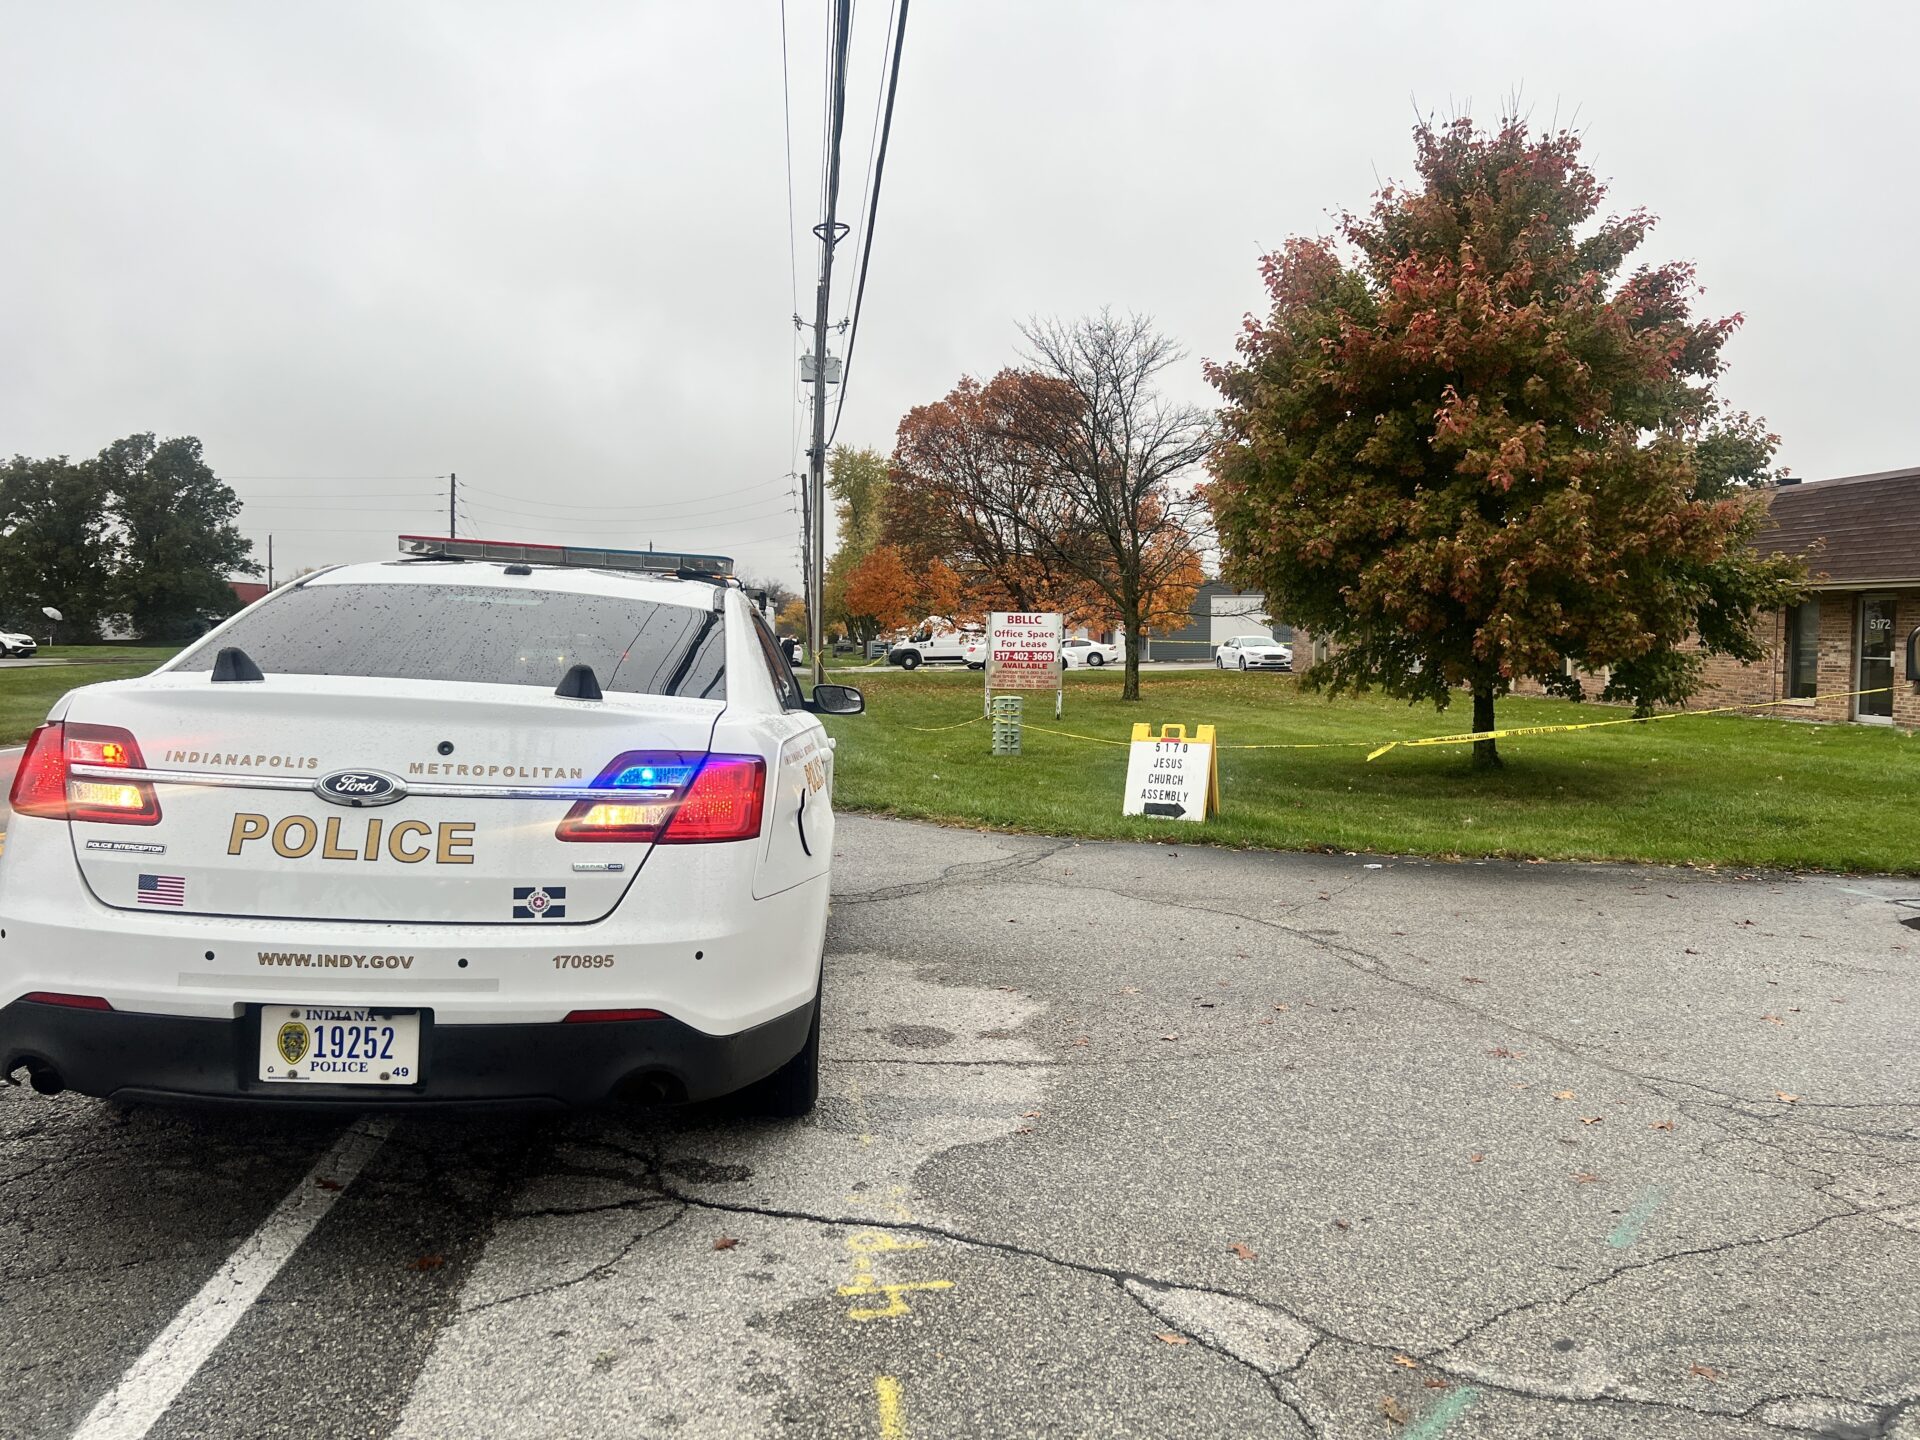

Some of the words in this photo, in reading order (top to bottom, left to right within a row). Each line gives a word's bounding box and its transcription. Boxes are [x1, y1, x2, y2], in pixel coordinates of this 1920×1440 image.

[1007, 615, 1042, 625] BBLLC
[1869, 619, 1891, 630] 5172
[994, 629, 1024, 638] Office
[1027, 630, 1055, 639] Space
[1001, 640, 1017, 648] For
[1020, 640, 1048, 648] Lease
[995, 651, 1053, 661] 317-402-3669
[1001, 662, 1048, 670] AVAILABLE
[164, 749, 320, 770] INDIANAPOLIS
[408, 761, 583, 780] METROPOLITAN
[1154, 758, 1182, 769] JESUS
[335, 774, 380, 793] Ford
[1148, 774, 1183, 785] CHURCH
[1141, 789, 1188, 802] ASSEMBLY
[227, 812, 476, 865] POLICE
[87, 841, 113, 849] POLICE
[113, 843, 164, 852] INTERCEPTOR
[257, 951, 415, 970] WWW.INDY.GOV
[552, 954, 615, 970] 170895
[305, 1009, 377, 1022] INDIANA
[313, 1025, 395, 1060] 19252
[309, 1061, 369, 1074] POLICE
[392, 1066, 410, 1078] 49
